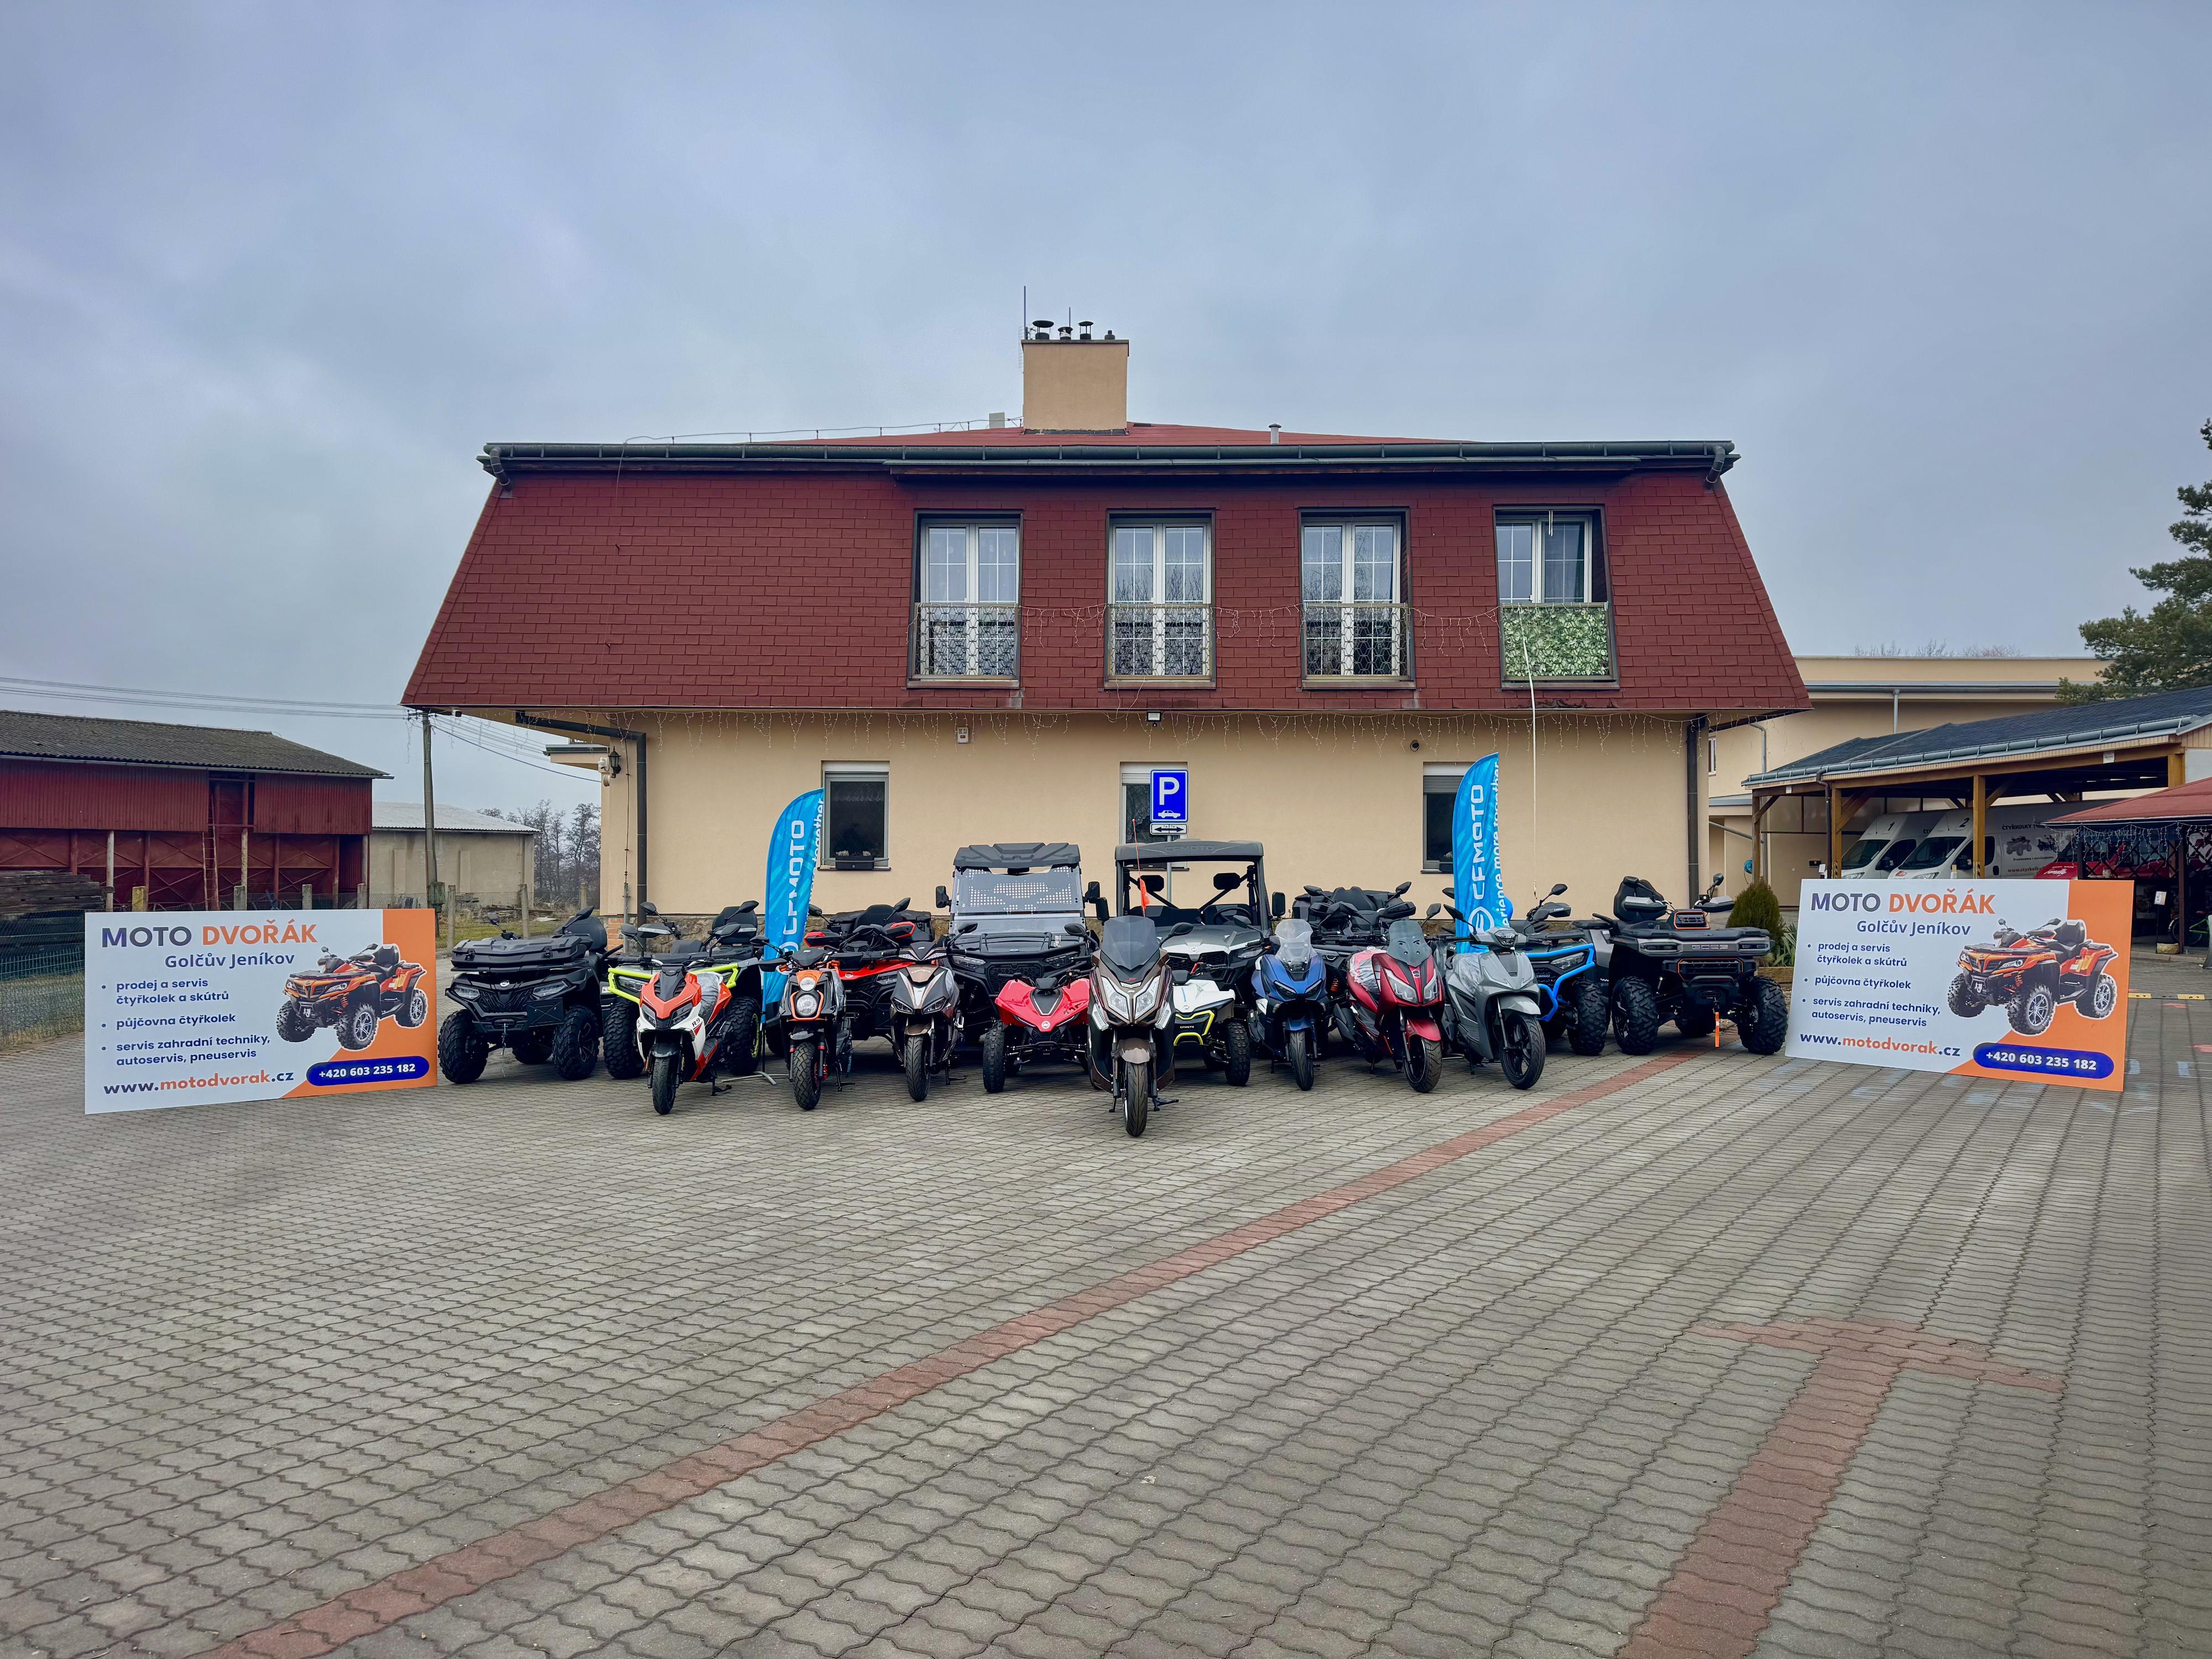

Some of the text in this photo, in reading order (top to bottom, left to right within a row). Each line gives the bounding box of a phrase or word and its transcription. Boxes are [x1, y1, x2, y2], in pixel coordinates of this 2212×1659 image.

[1160, 777, 1180, 805] P
[1888, 822, 1896, 831] 1
[1959, 817, 1970, 828] 2
[1470, 784, 1485, 900] CFMOTO
[1811, 889, 1995, 914] MOTO DVOŘÁK
[102, 919, 317, 947] MOTO DVOŘÁK
[1858, 920, 1970, 936] Golčův Jeníkov
[1818, 942, 1849, 953] prodej
[165, 952, 294, 969] Golčův Jeníkov
[1817, 954, 1862, 967] čtyřkolek
[1874, 957, 1907, 966] skútrů
[117, 980, 156, 993] prodej
[172, 978, 208, 988] servis
[1815, 975, 1911, 989] půjčovna čtyřkolek
[117, 994, 175, 1006] čtyřkolek
[190, 991, 228, 1001] skútrů
[1813, 998, 1940, 1016] servis zahradní techniky,
[117, 1014, 236, 1030] půjčovna čtyřkolek
[692, 1018, 701, 1027] R9
[1812, 1011, 1926, 1026] autoservis, pneuservis
[117, 1035, 270, 1051] servis zahradní techniky,
[1801, 1034, 1960, 1056] www.motodvorak.cz
[117, 1049, 256, 1066] autoservis, pneuservis
[1986, 1051, 2096, 1070] +420 603 235 182
[319, 1063, 416, 1078] +420 603 235 182
[103, 1070, 294, 1095] www.motodvorak.cz
